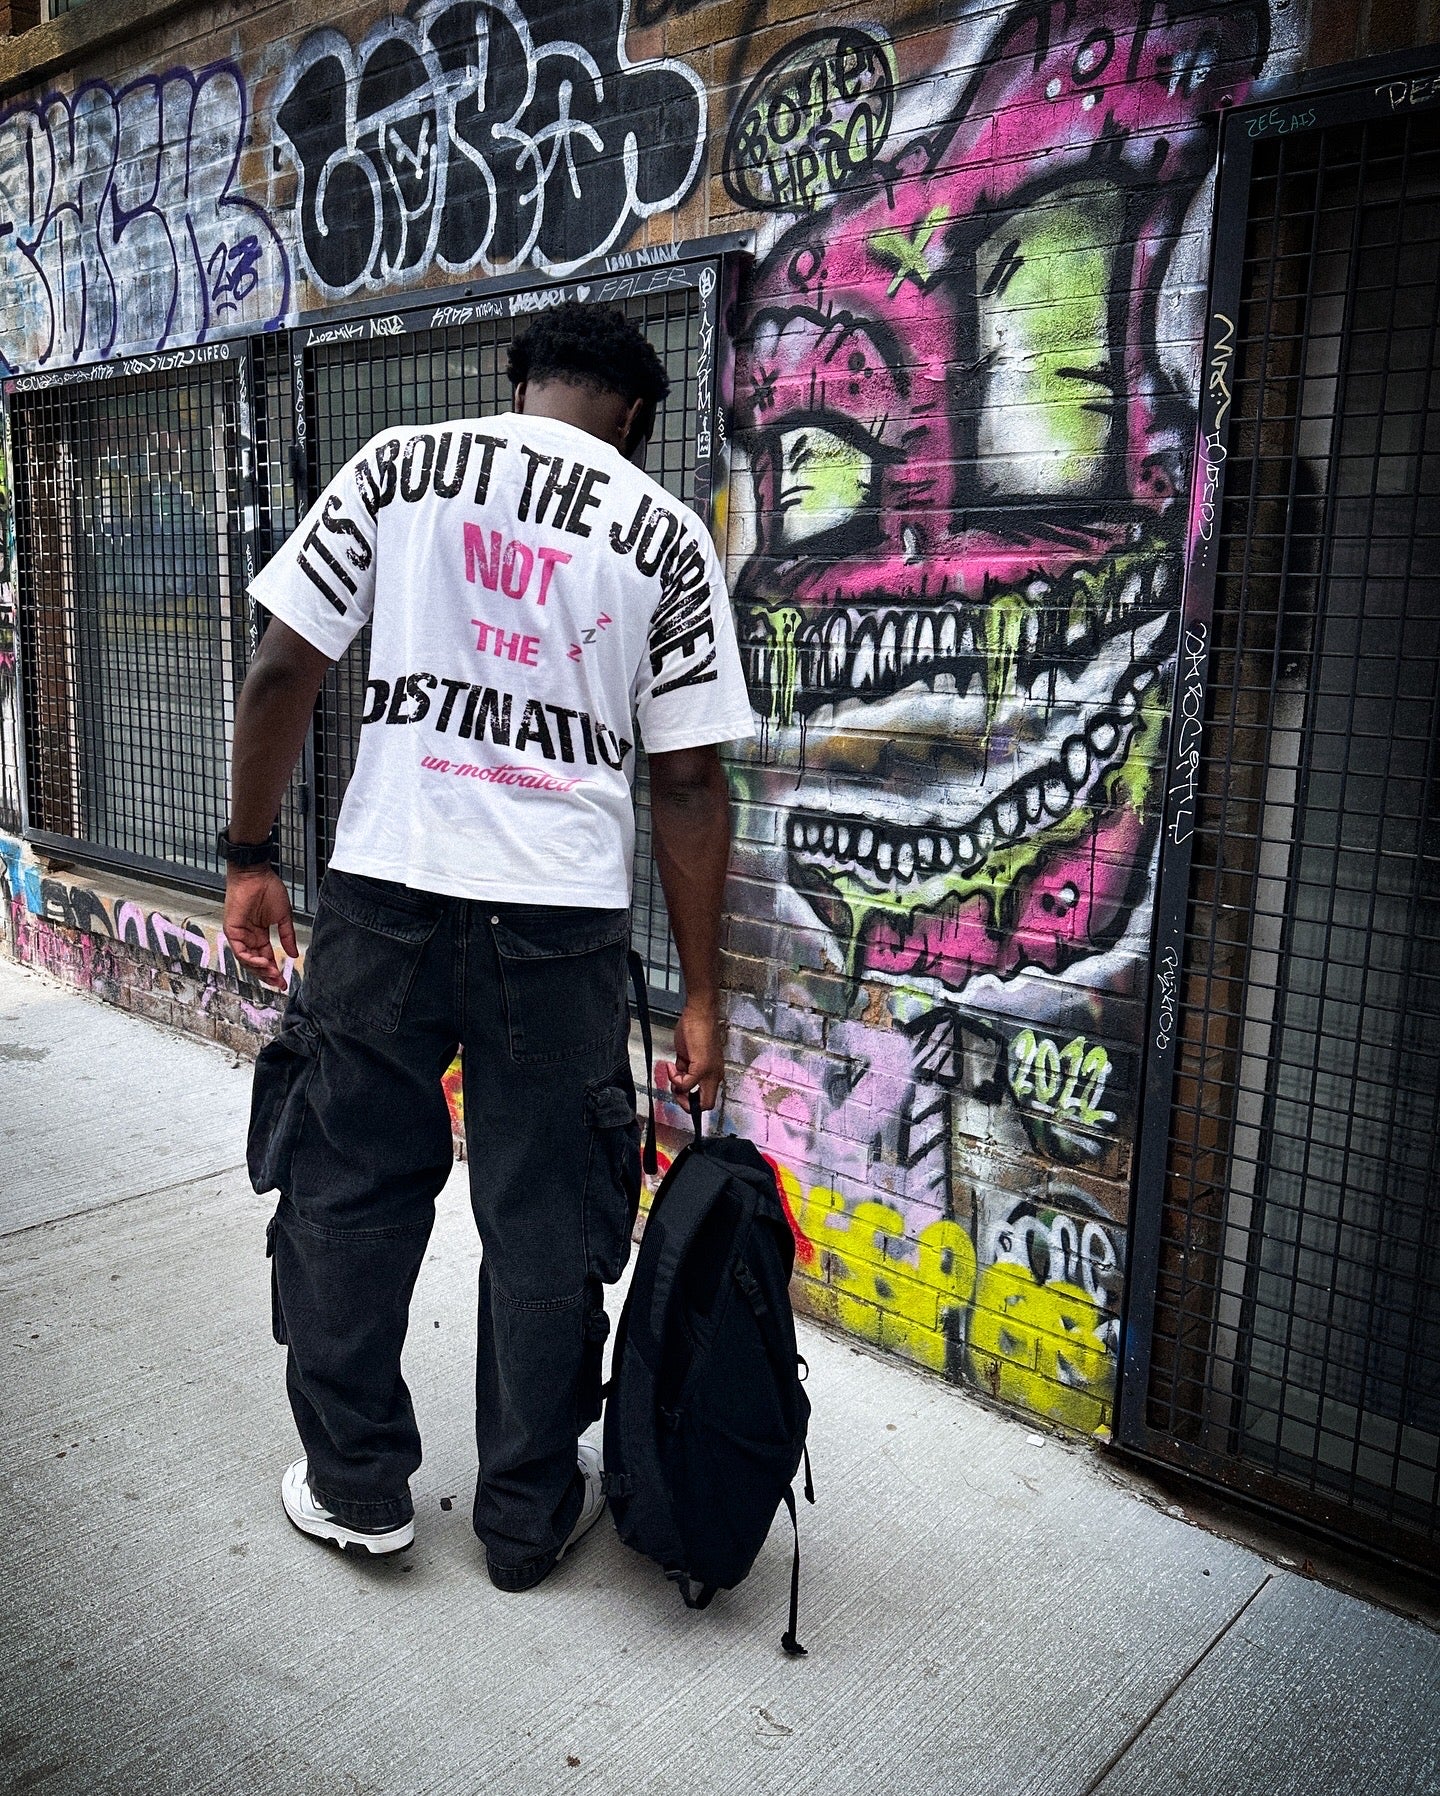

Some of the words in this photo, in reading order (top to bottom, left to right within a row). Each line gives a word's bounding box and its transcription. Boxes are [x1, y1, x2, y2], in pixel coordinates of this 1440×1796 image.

[597, 267, 693, 301] FALER
[296, 494, 373, 617] ITS
[354, 431, 509, 527] ABOUT
[517, 444, 611, 539] THE
[608, 493, 718, 699] JOURNEY
[463, 521, 573, 606] NOT
[470, 618, 541, 667] THE
[421, 754, 598, 792] un-motivated
